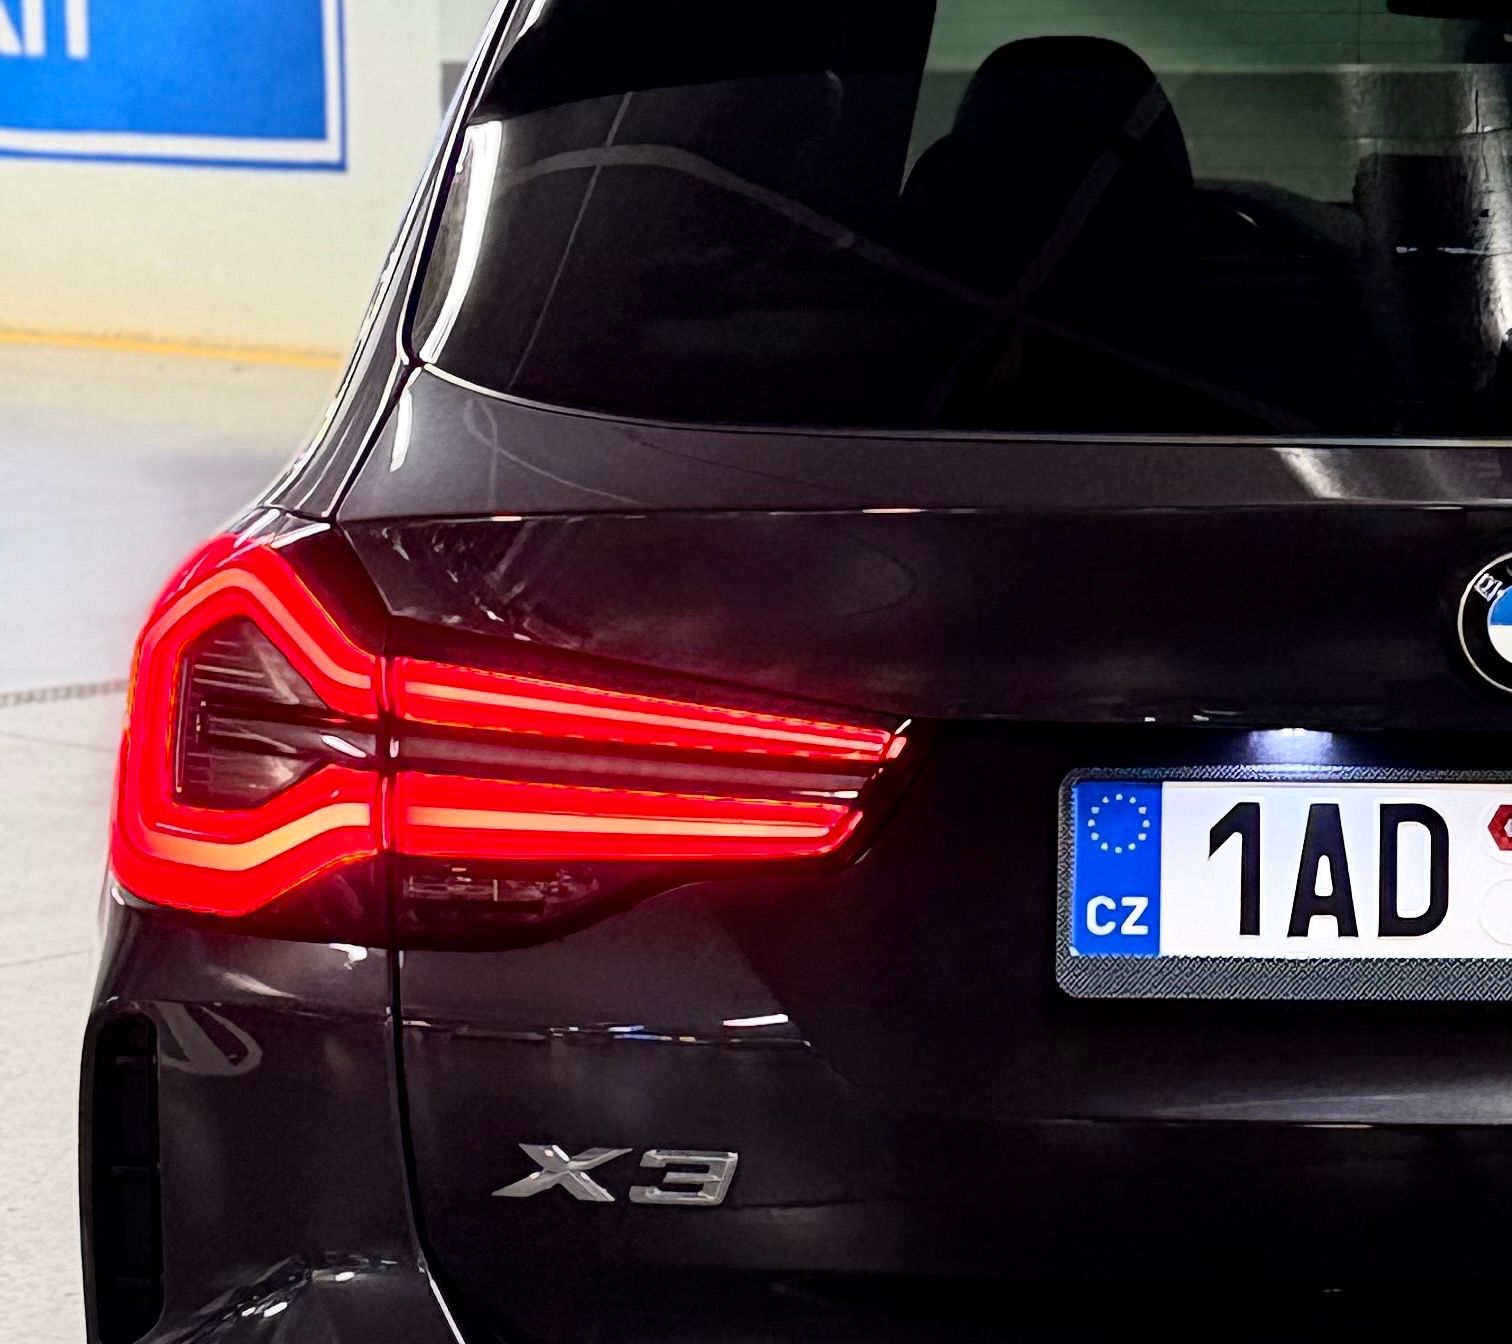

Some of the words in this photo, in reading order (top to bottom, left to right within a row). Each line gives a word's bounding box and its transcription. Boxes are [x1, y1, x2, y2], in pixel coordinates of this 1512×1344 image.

[1207, 801, 1451, 938] 1AD
[1086, 895, 1149, 936] CZ
[491, 1142, 739, 1206] X3
